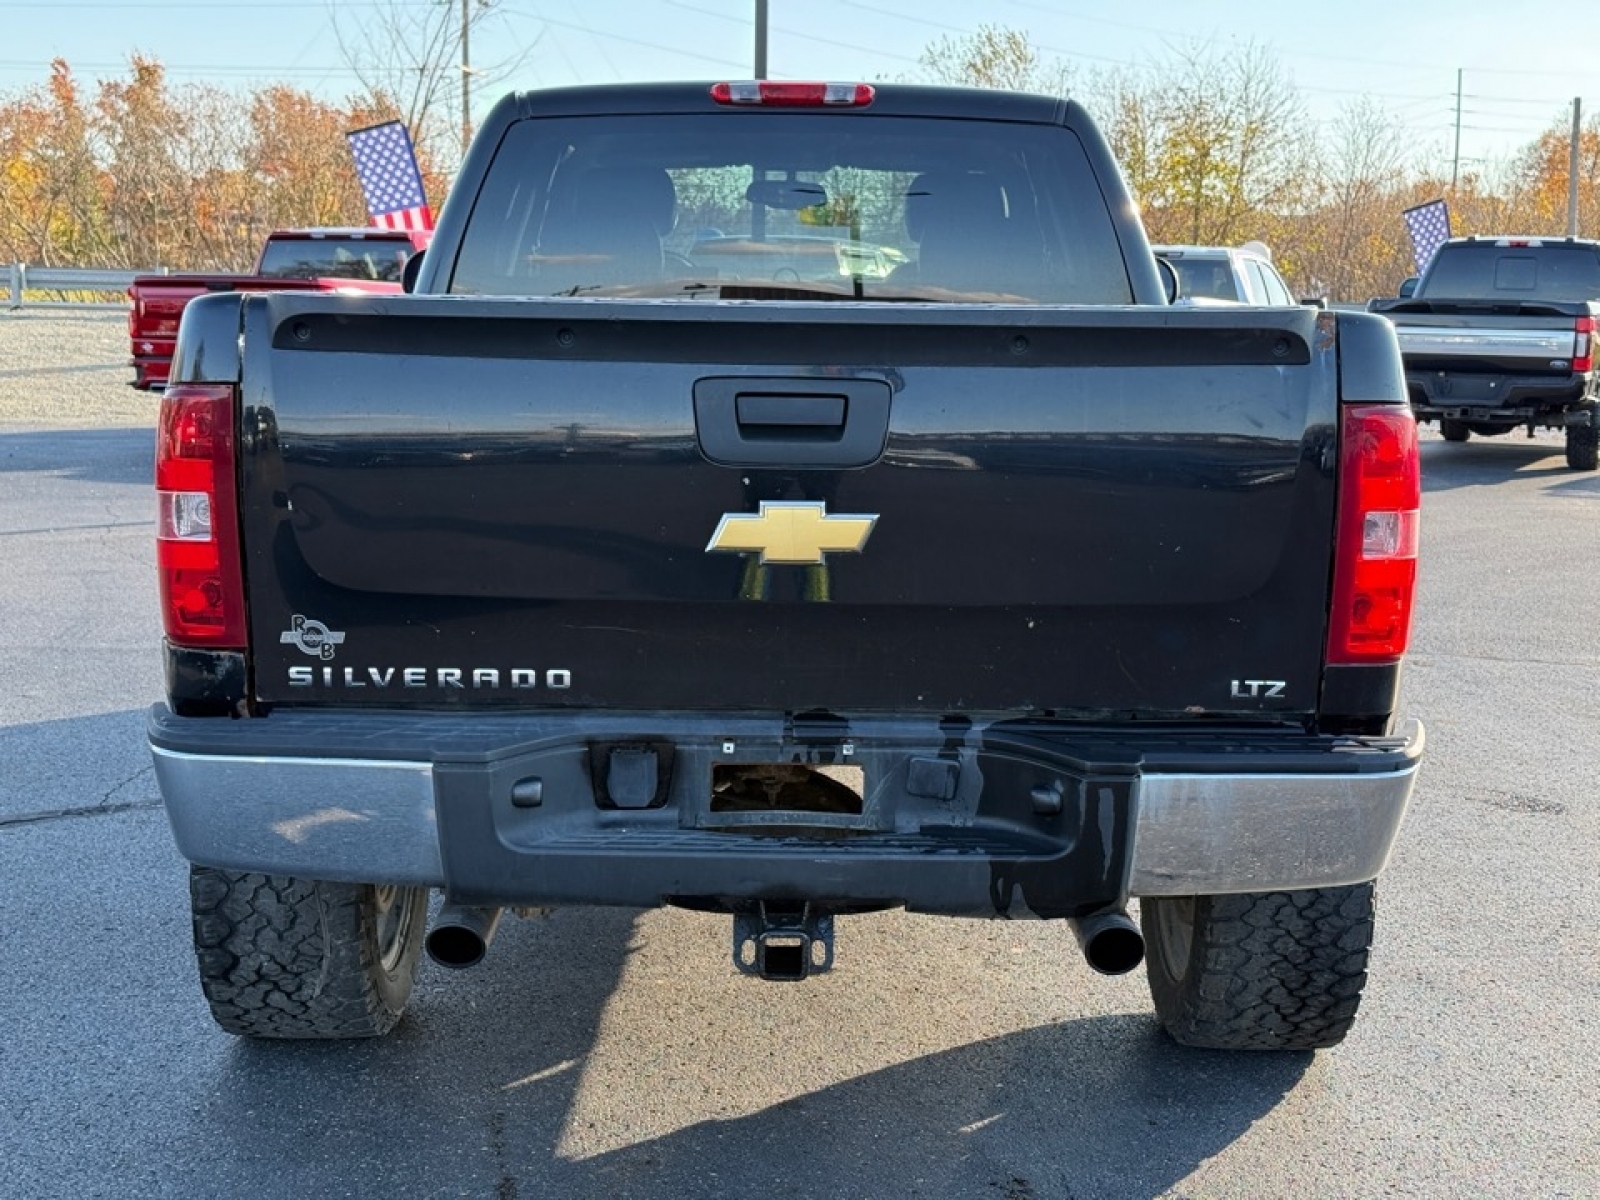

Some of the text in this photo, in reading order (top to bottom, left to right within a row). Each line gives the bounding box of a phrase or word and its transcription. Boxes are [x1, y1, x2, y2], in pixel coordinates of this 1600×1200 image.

[291, 614, 307, 633] R
[320, 643, 335, 660] B
[288, 666, 571, 689] SILVERADO
[1231, 679, 1286, 698] LTZ
